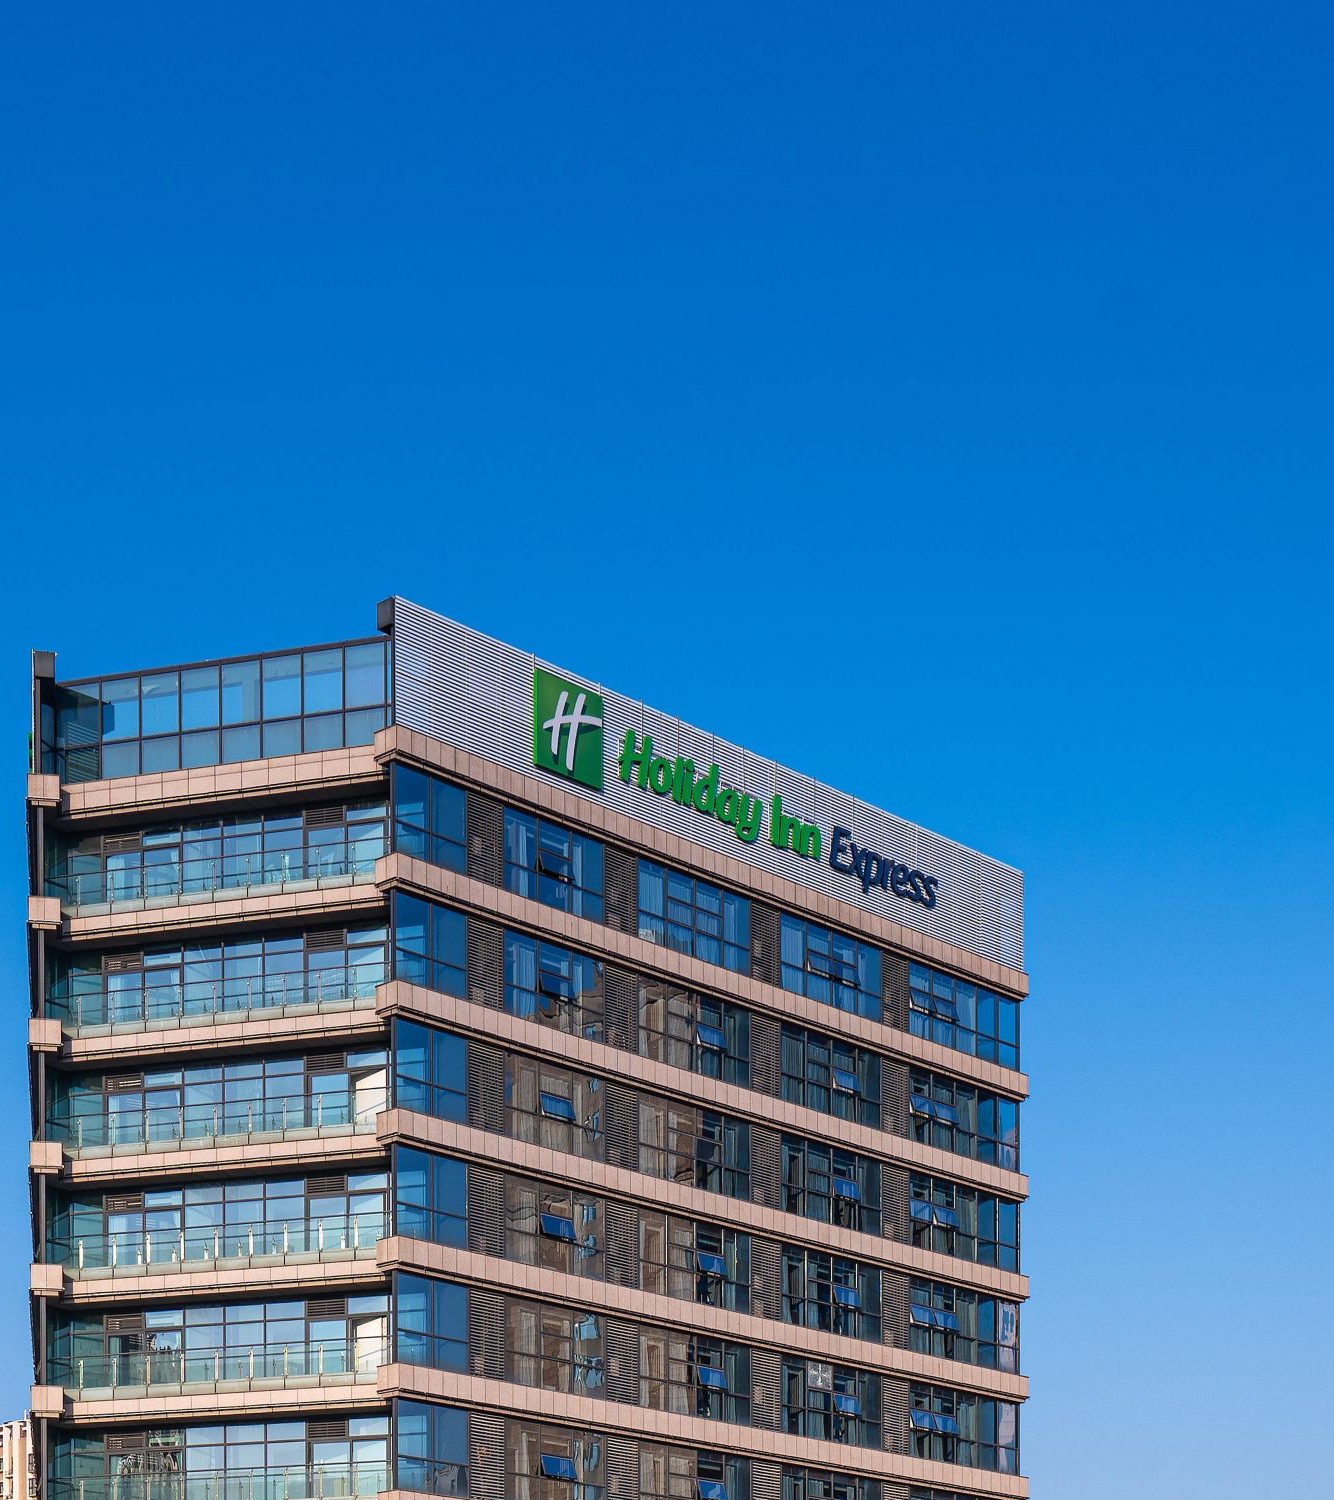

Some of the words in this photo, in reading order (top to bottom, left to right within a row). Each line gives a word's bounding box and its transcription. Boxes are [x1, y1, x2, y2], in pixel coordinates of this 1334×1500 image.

[618, 728, 763, 843] Holiday
[770, 794, 822, 862] Inn
[829, 825, 939, 909] Express
